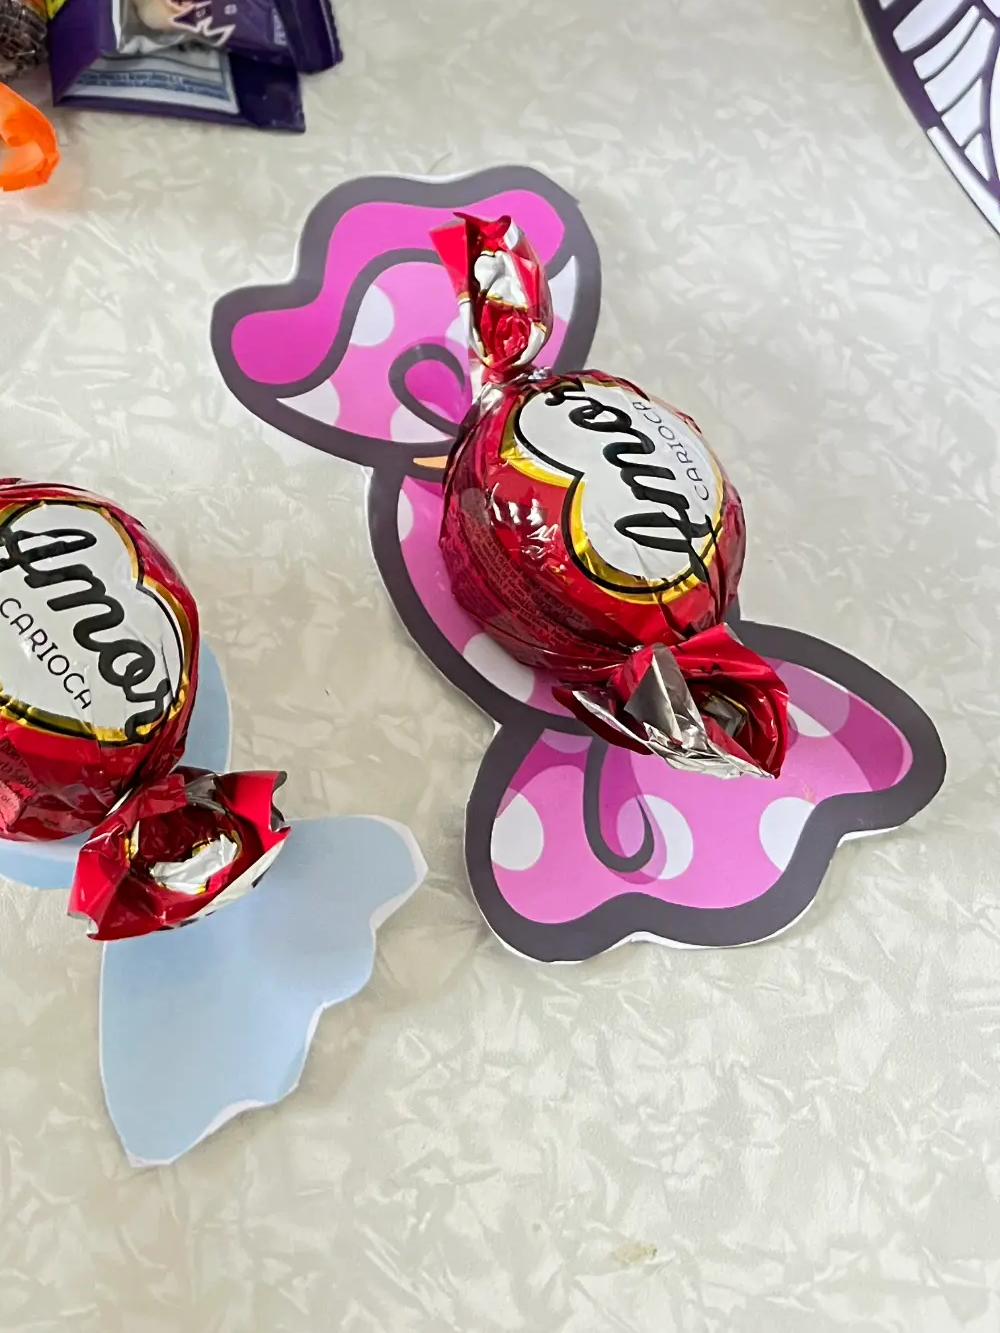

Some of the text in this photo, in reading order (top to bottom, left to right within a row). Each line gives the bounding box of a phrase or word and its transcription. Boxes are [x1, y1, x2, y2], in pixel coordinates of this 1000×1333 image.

[545, 378, 714, 582] Amor
[632, 401, 710, 501] CARIOCA
[0, 597, 92, 710] CARIOCA
